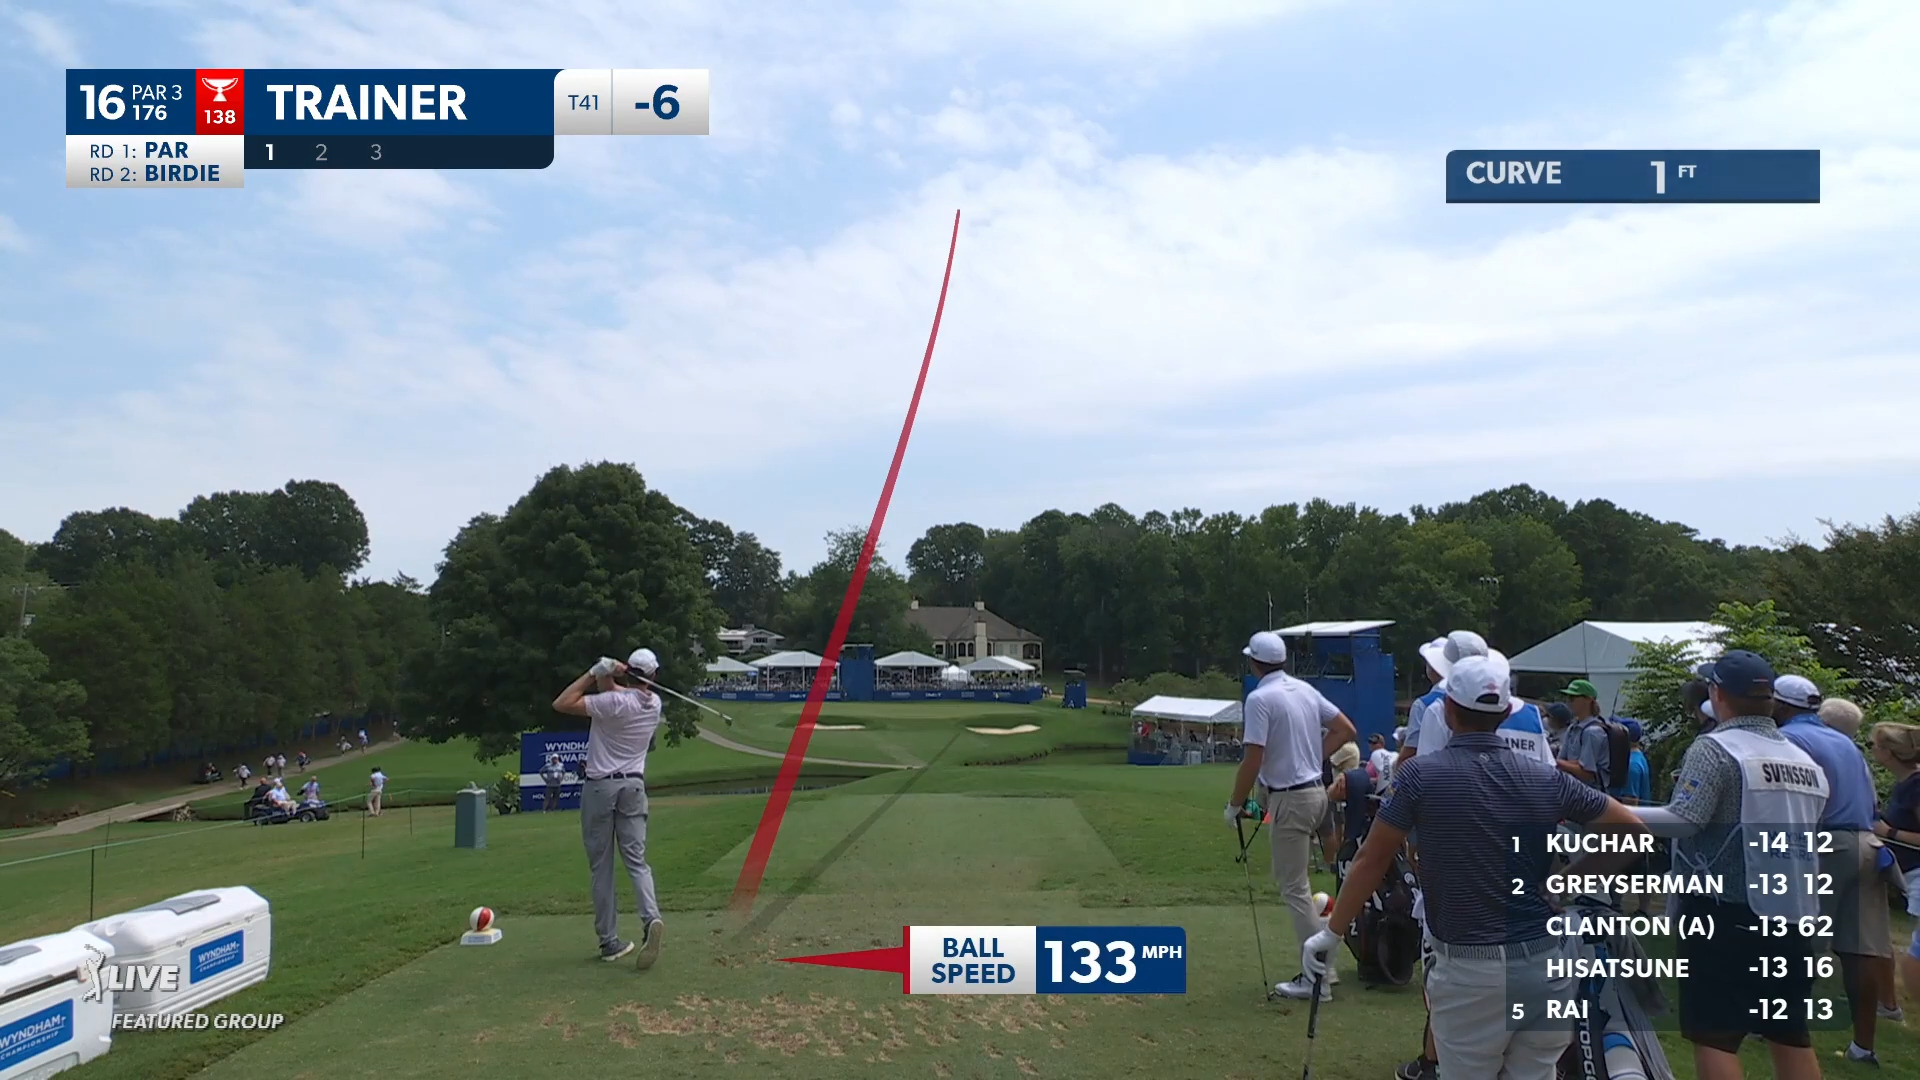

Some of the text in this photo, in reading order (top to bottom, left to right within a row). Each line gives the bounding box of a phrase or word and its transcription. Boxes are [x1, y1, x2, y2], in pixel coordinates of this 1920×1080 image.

[1762, 763, 1819, 788] SVENSSON
[199, 941, 237, 963] WYNDHAM
[0, 1014, 61, 1049] WYNDHAM
[1, 1031, 58, 1060] CHAMPIONSHIP
